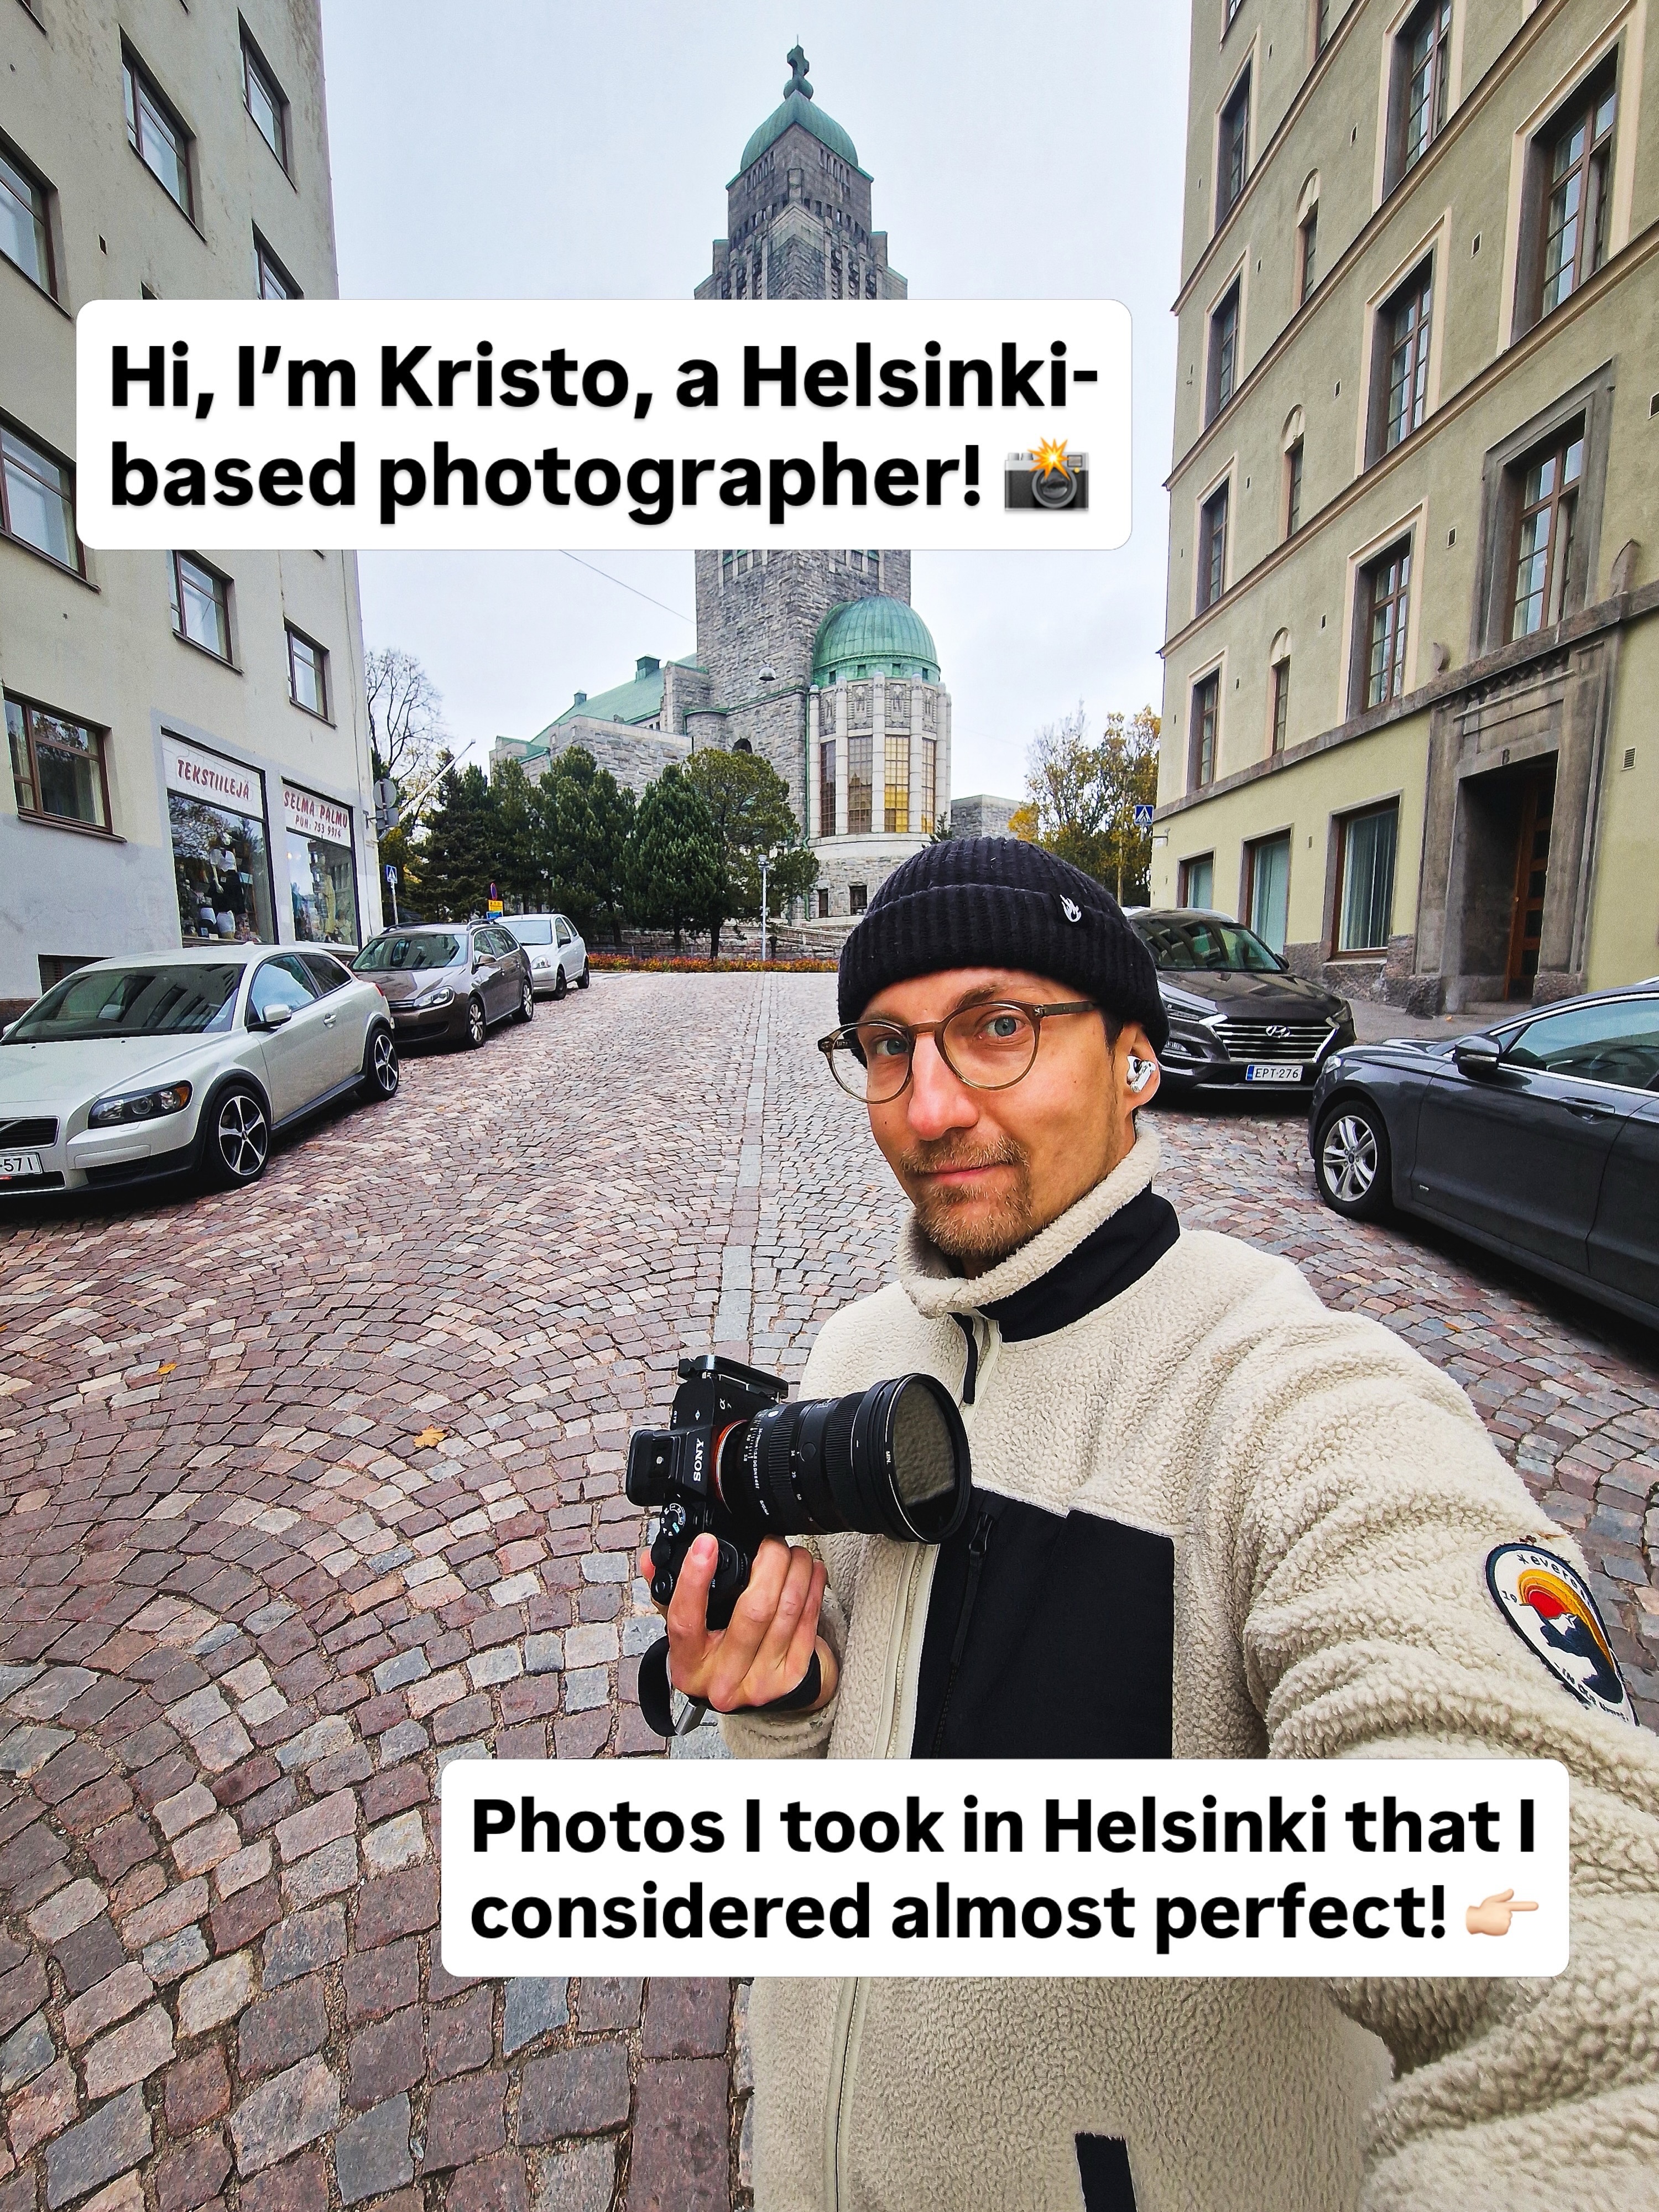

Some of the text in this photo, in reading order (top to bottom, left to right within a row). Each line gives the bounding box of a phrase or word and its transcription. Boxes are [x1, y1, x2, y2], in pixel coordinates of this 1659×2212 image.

[178, 759, 249, 800] TEKSTIILEJÄ
[284, 790, 348, 828] SELMA PALMU
[314, 821, 325, 834] 753
[1255, 1068, 1298, 1078] EPT-276
[693, 1438, 704, 1481] SONY
